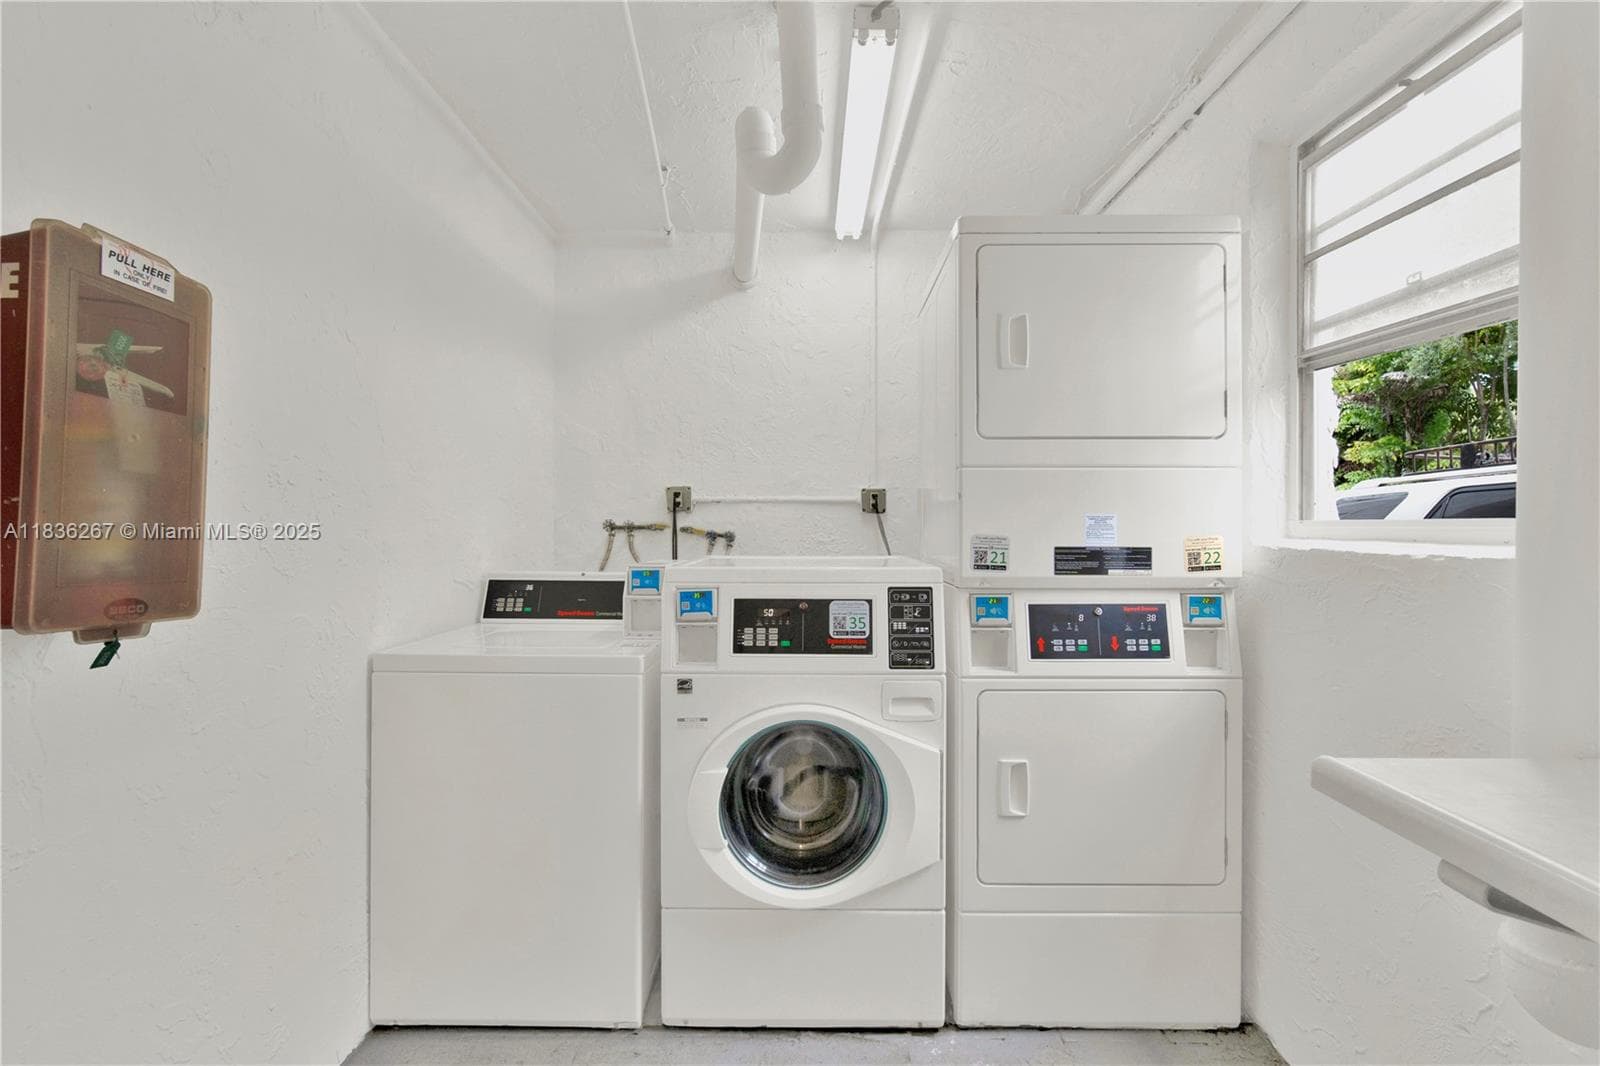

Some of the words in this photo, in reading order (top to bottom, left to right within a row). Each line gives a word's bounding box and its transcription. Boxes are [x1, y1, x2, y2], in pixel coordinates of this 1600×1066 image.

[108, 250, 137, 269] PULL
[142, 264, 171, 283] HERE
[113, 269, 121, 277] IN
[123, 273, 140, 285] CASE
[990, 551, 1007, 564] 21
[1204, 551, 1221, 565] 22
[848, 616, 866, 630] 35
